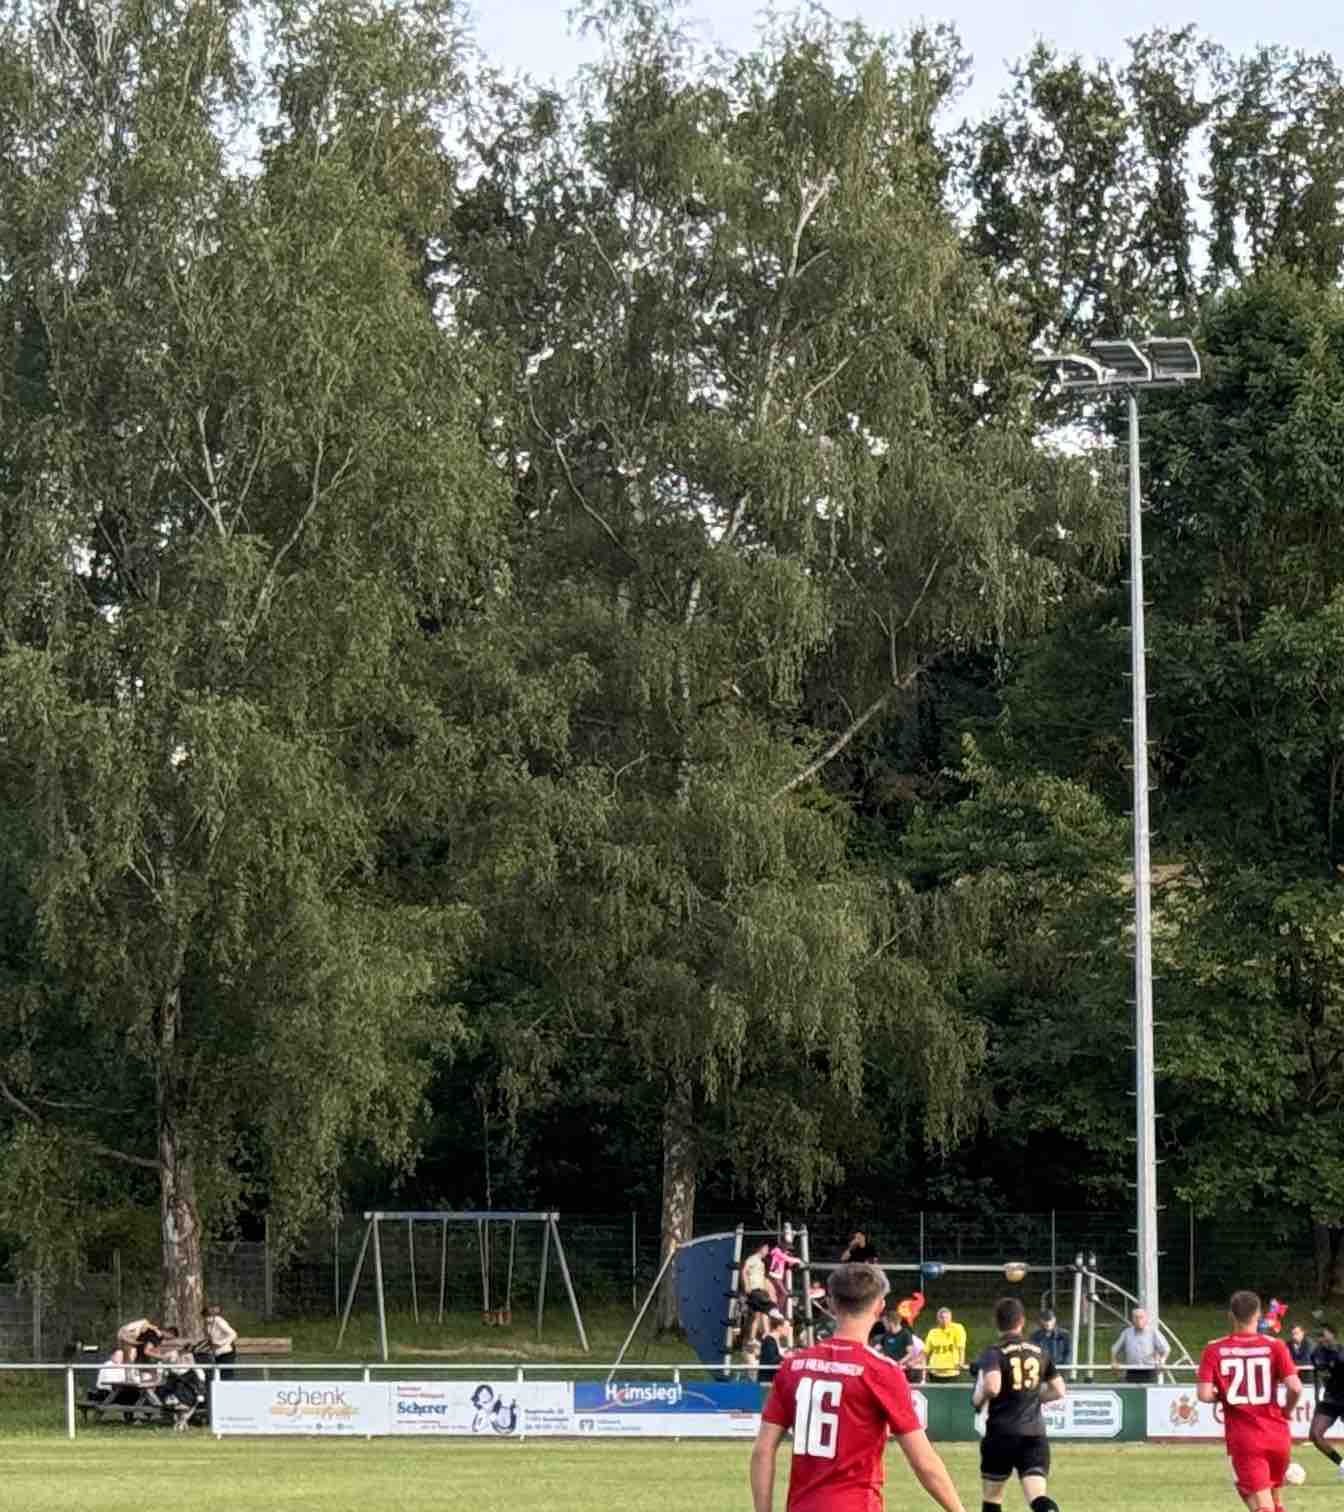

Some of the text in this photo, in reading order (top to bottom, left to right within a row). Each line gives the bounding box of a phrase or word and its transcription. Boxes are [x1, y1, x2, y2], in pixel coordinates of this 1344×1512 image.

[1010, 1356, 1041, 1391] 13
[1220, 1357, 1272, 1406] 20
[276, 1384, 346, 1406] schenk
[794, 1376, 843, 1460] 16
